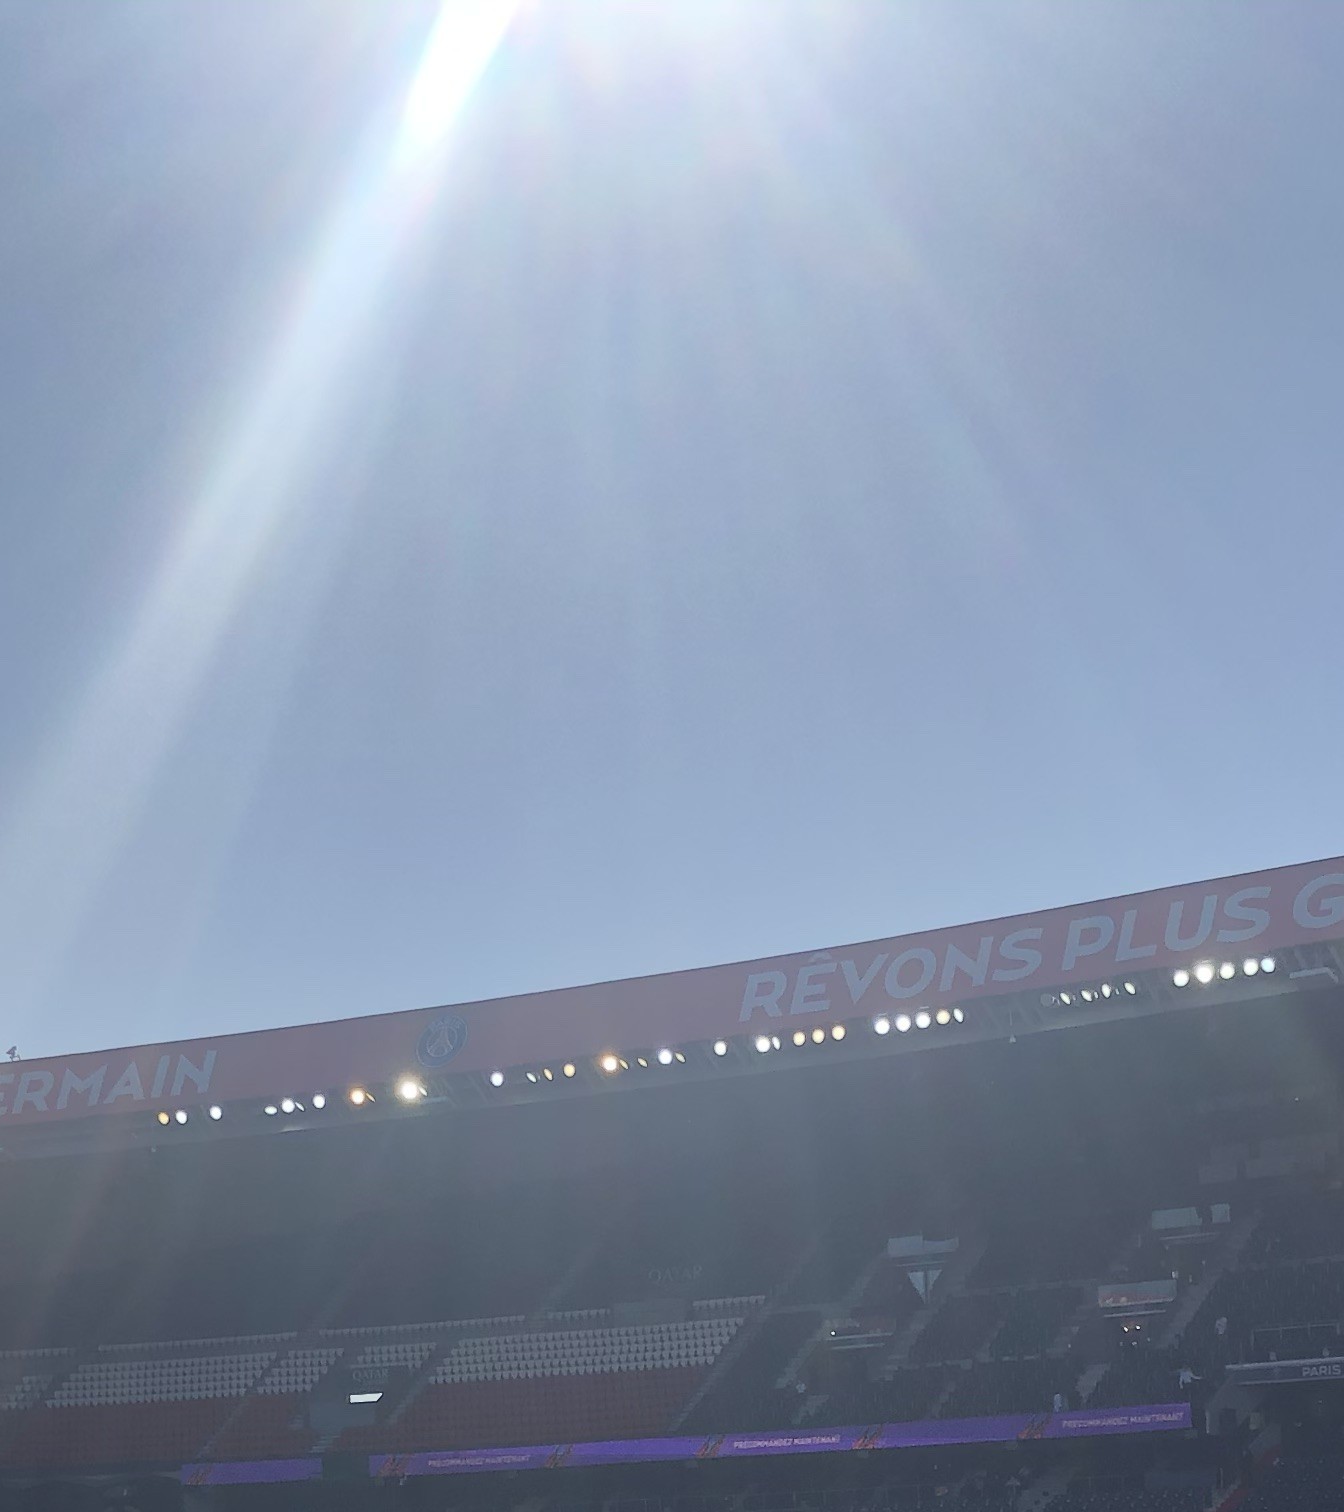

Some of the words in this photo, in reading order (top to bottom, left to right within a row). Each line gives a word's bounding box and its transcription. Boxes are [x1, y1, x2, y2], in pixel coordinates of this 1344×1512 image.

[737, 928, 1043, 1024] RÊVONS
[1061, 886, 1271, 972] PLUS
[1301, 1364, 1341, 1377] PARIS
